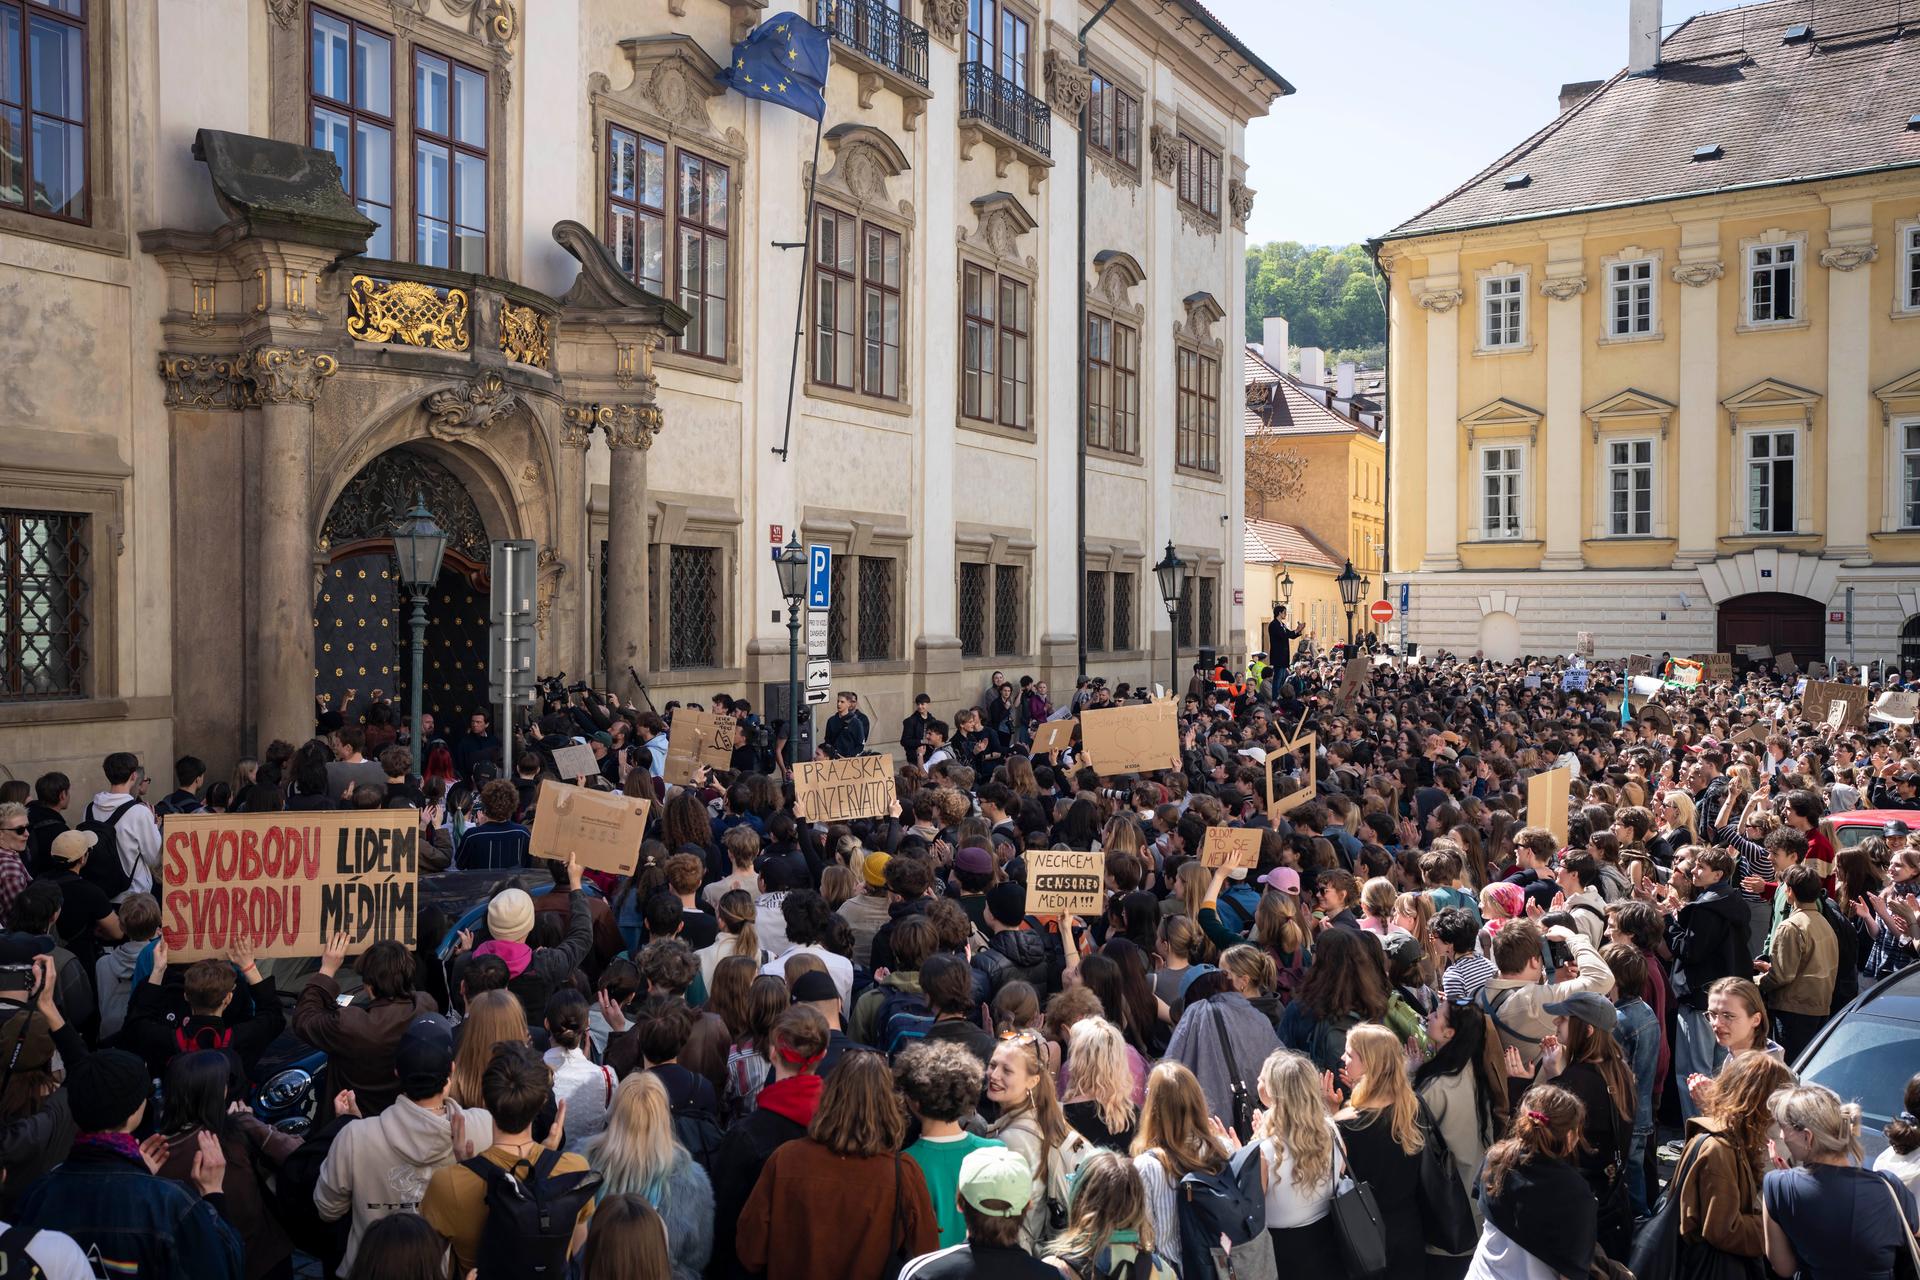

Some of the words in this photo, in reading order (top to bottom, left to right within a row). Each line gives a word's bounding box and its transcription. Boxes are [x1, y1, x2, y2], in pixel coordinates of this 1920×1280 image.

[814, 550, 826, 585] P
[164, 826, 321, 886] SVOBODU
[337, 827, 416, 874] LIDEM
[1211, 839, 1226, 850] TO
[1233, 838, 1252, 851] SE
[1035, 854, 1094, 869] NECHCEM
[1037, 877, 1099, 890] CENSORED
[163, 884, 302, 951] SVOBODU
